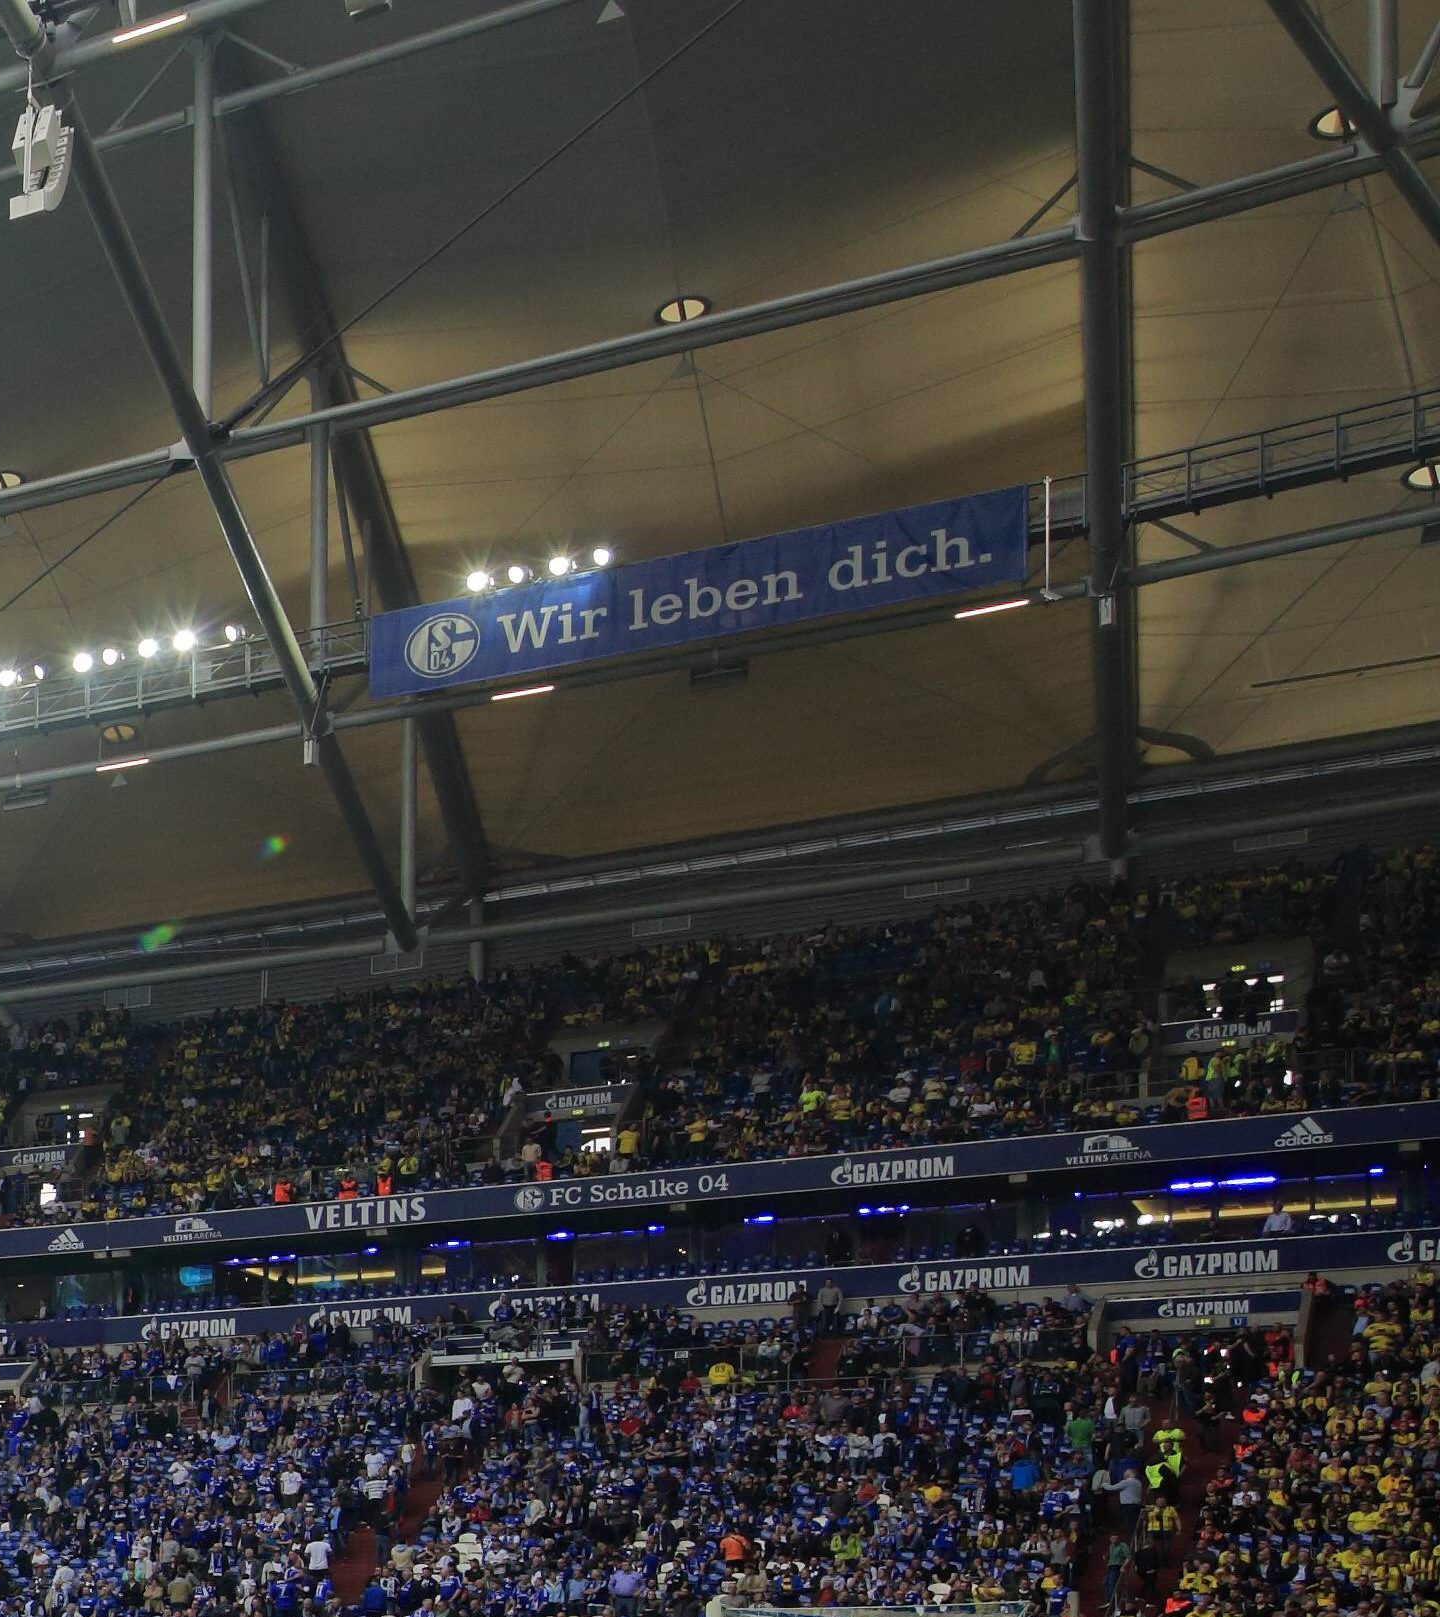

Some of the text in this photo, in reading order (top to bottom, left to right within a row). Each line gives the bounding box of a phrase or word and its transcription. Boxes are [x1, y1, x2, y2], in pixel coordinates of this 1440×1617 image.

[497, 529, 992, 655] Wir leben dich.
[559, 1092, 611, 1108] GAZPROM
[1274, 1130, 1334, 1147] adidas
[22, 1151, 65, 1165] GAZPROM
[1066, 1149, 1152, 1165] VELTINS ARENA
[852, 1156, 954, 1183] GAZPROM
[550, 1173, 729, 1206] FC Schalke 04
[304, 1197, 426, 1231] VELTINS
[48, 1241, 84, 1251] adidas
[164, 1229, 222, 1243] VELTINS ARENA
[1163, 1250, 1279, 1277] GAZPROM
[924, 1265, 1030, 1291] GAZPROM
[710, 1280, 808, 1306] GAZPROM
[1177, 1298, 1249, 1315] GAZPROM
[160, 1318, 236, 1339] GAZPROM
